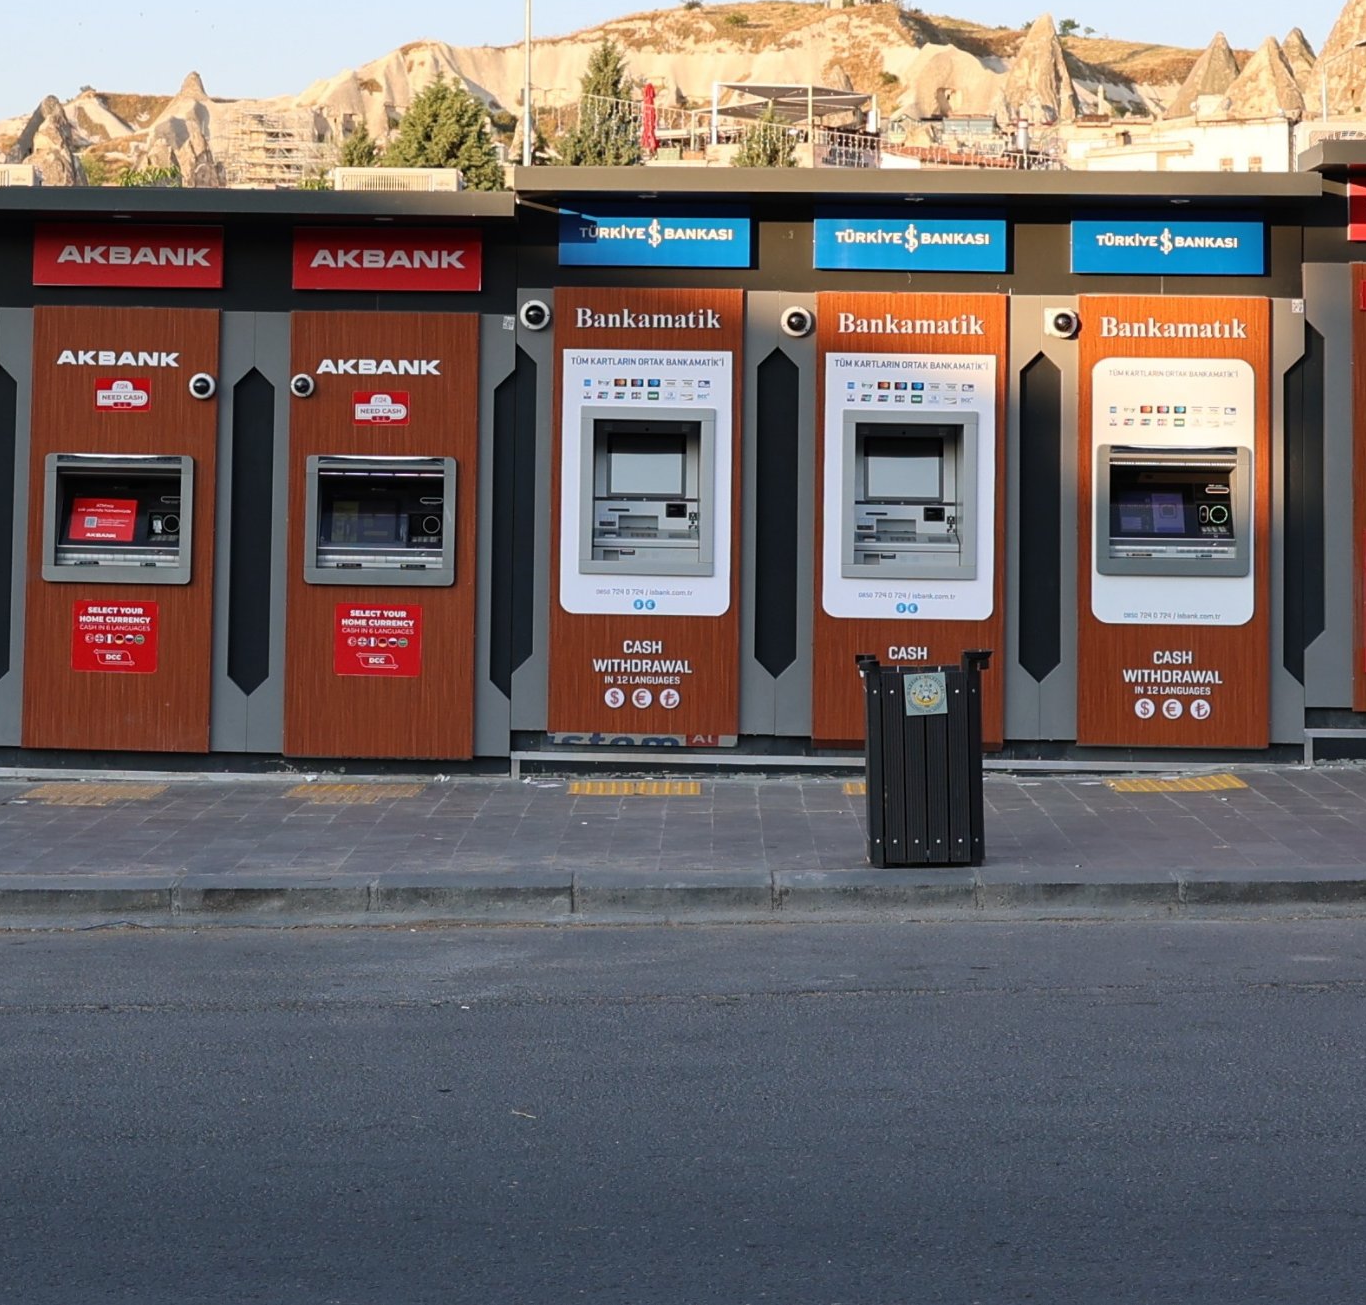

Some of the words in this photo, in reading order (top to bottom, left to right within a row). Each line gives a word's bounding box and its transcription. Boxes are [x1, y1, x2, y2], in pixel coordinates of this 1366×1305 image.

[579, 224, 646, 240] TÜRKİYE
[664, 228, 733, 240] BANKASI
[835, 229, 903, 244] TÜRKİYE
[921, 232, 990, 245] BANKASI
[1096, 233, 1158, 246] TÜRKİYE
[1175, 236, 1238, 249] BANKASI
[57, 245, 212, 267] AKBANK
[310, 249, 465, 269] AKBANK
[576, 307, 721, 329] Bankamatik
[838, 312, 985, 335] Bankamatik
[57, 350, 180, 368] AKBANK
[571, 356, 590, 366] TÜM
[590, 357, 636, 366] KARTLARIN
[638, 358, 665, 366] ORTAK
[835, 358, 852, 368] TÜM
[854, 359, 900, 369] KARTLARIN
[902, 361, 929, 369] ORTAK
[316, 359, 441, 375] AKBANK
[87, 606, 118, 614] SELECT
[350, 609, 381, 617] SELECT
[382, 610, 407, 618] YOUR
[106, 616, 151, 624] CURRENCY
[368, 619, 414, 627] CURRENCY
[623, 640, 662, 654] CASH
[888, 646, 928, 660] CASH
[1153, 651, 1192, 664] CASH
[593, 659, 693, 673] WITHDRAWAL
[604, 675, 614, 684] IN
[617, 676, 628, 684] 12
[629, 676, 680, 685] LANGUAGES
[1123, 669, 1223, 684] WITHDRAWAL
[1135, 686, 1144, 694] IN
[1147, 686, 1159, 694] 12
[1160, 686, 1211, 695] LANGUAGES
